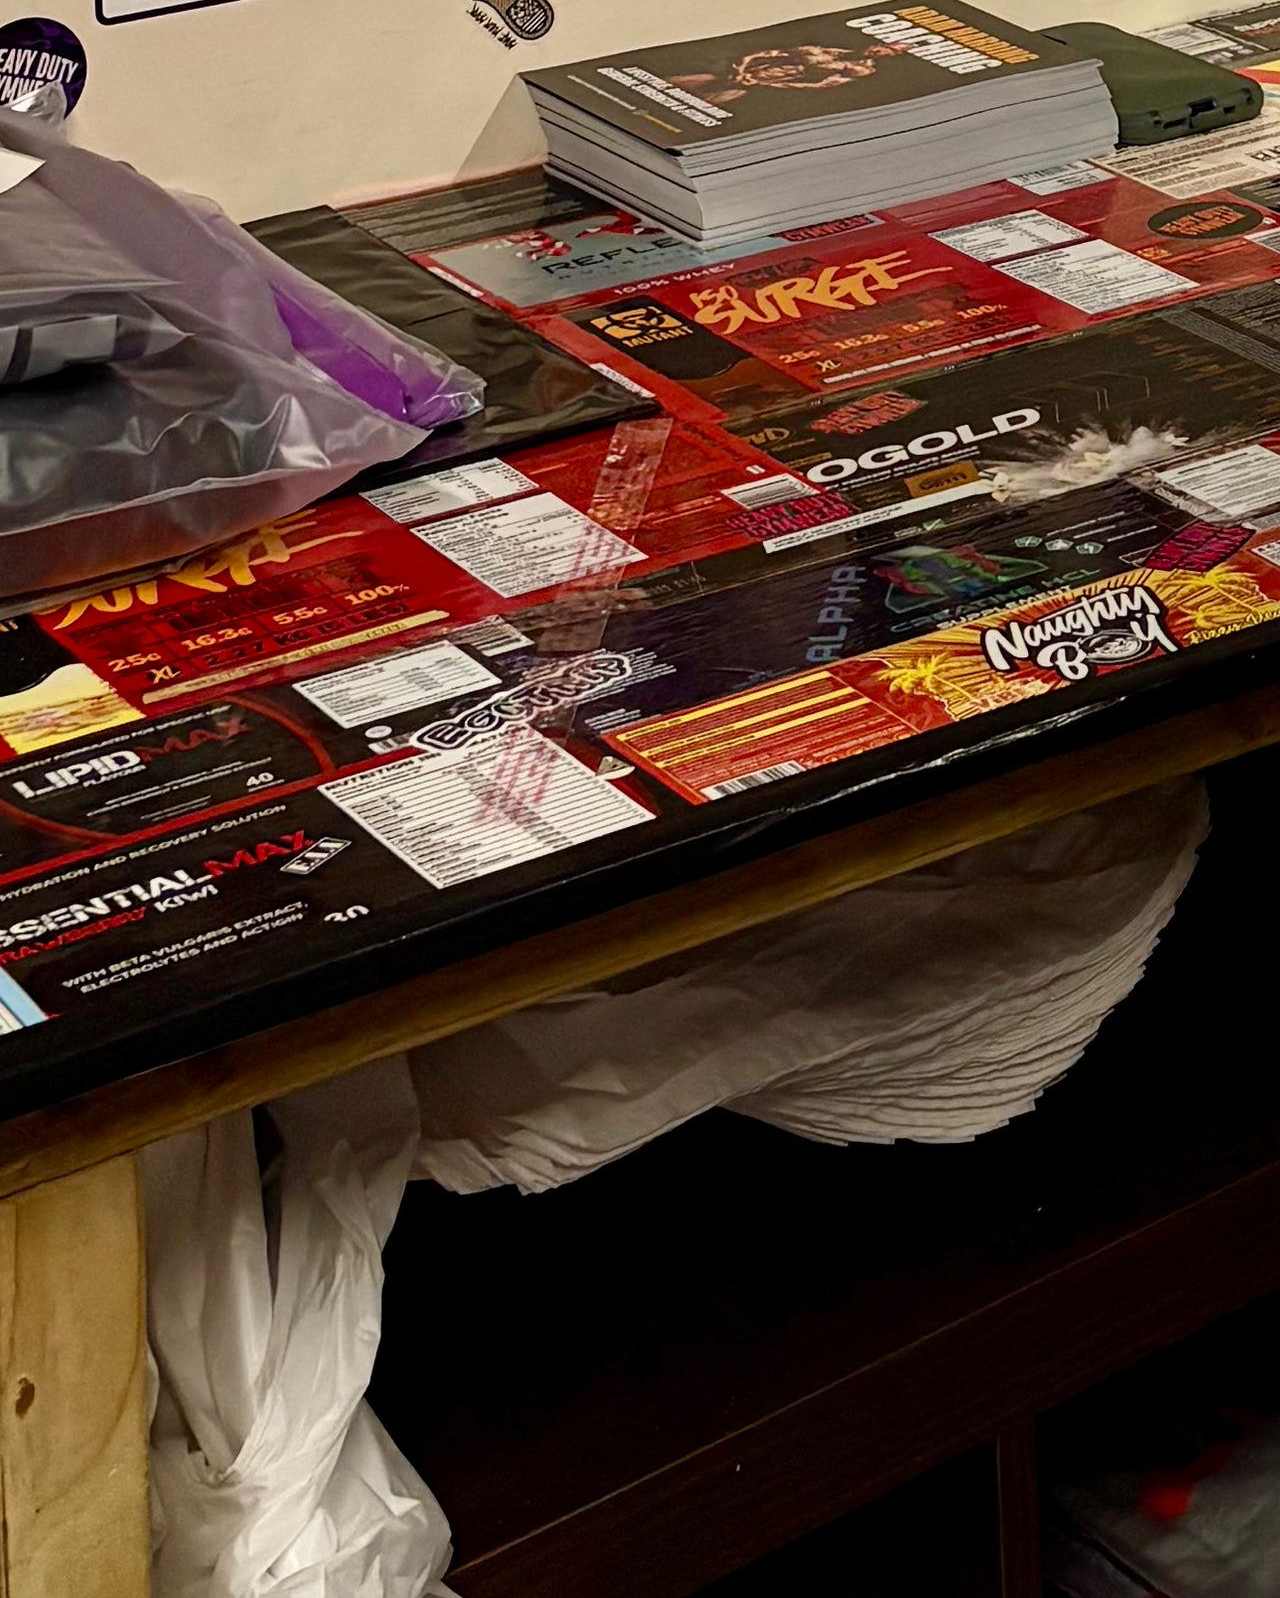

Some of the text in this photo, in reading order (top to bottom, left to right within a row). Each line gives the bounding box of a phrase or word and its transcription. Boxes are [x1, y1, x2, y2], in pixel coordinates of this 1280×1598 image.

[846, 12, 1004, 75] COACHING
[37, 52, 78, 83] DUTY
[984, 585, 1158, 672] Naughty
[128, 827, 207, 859] RECOVERY
